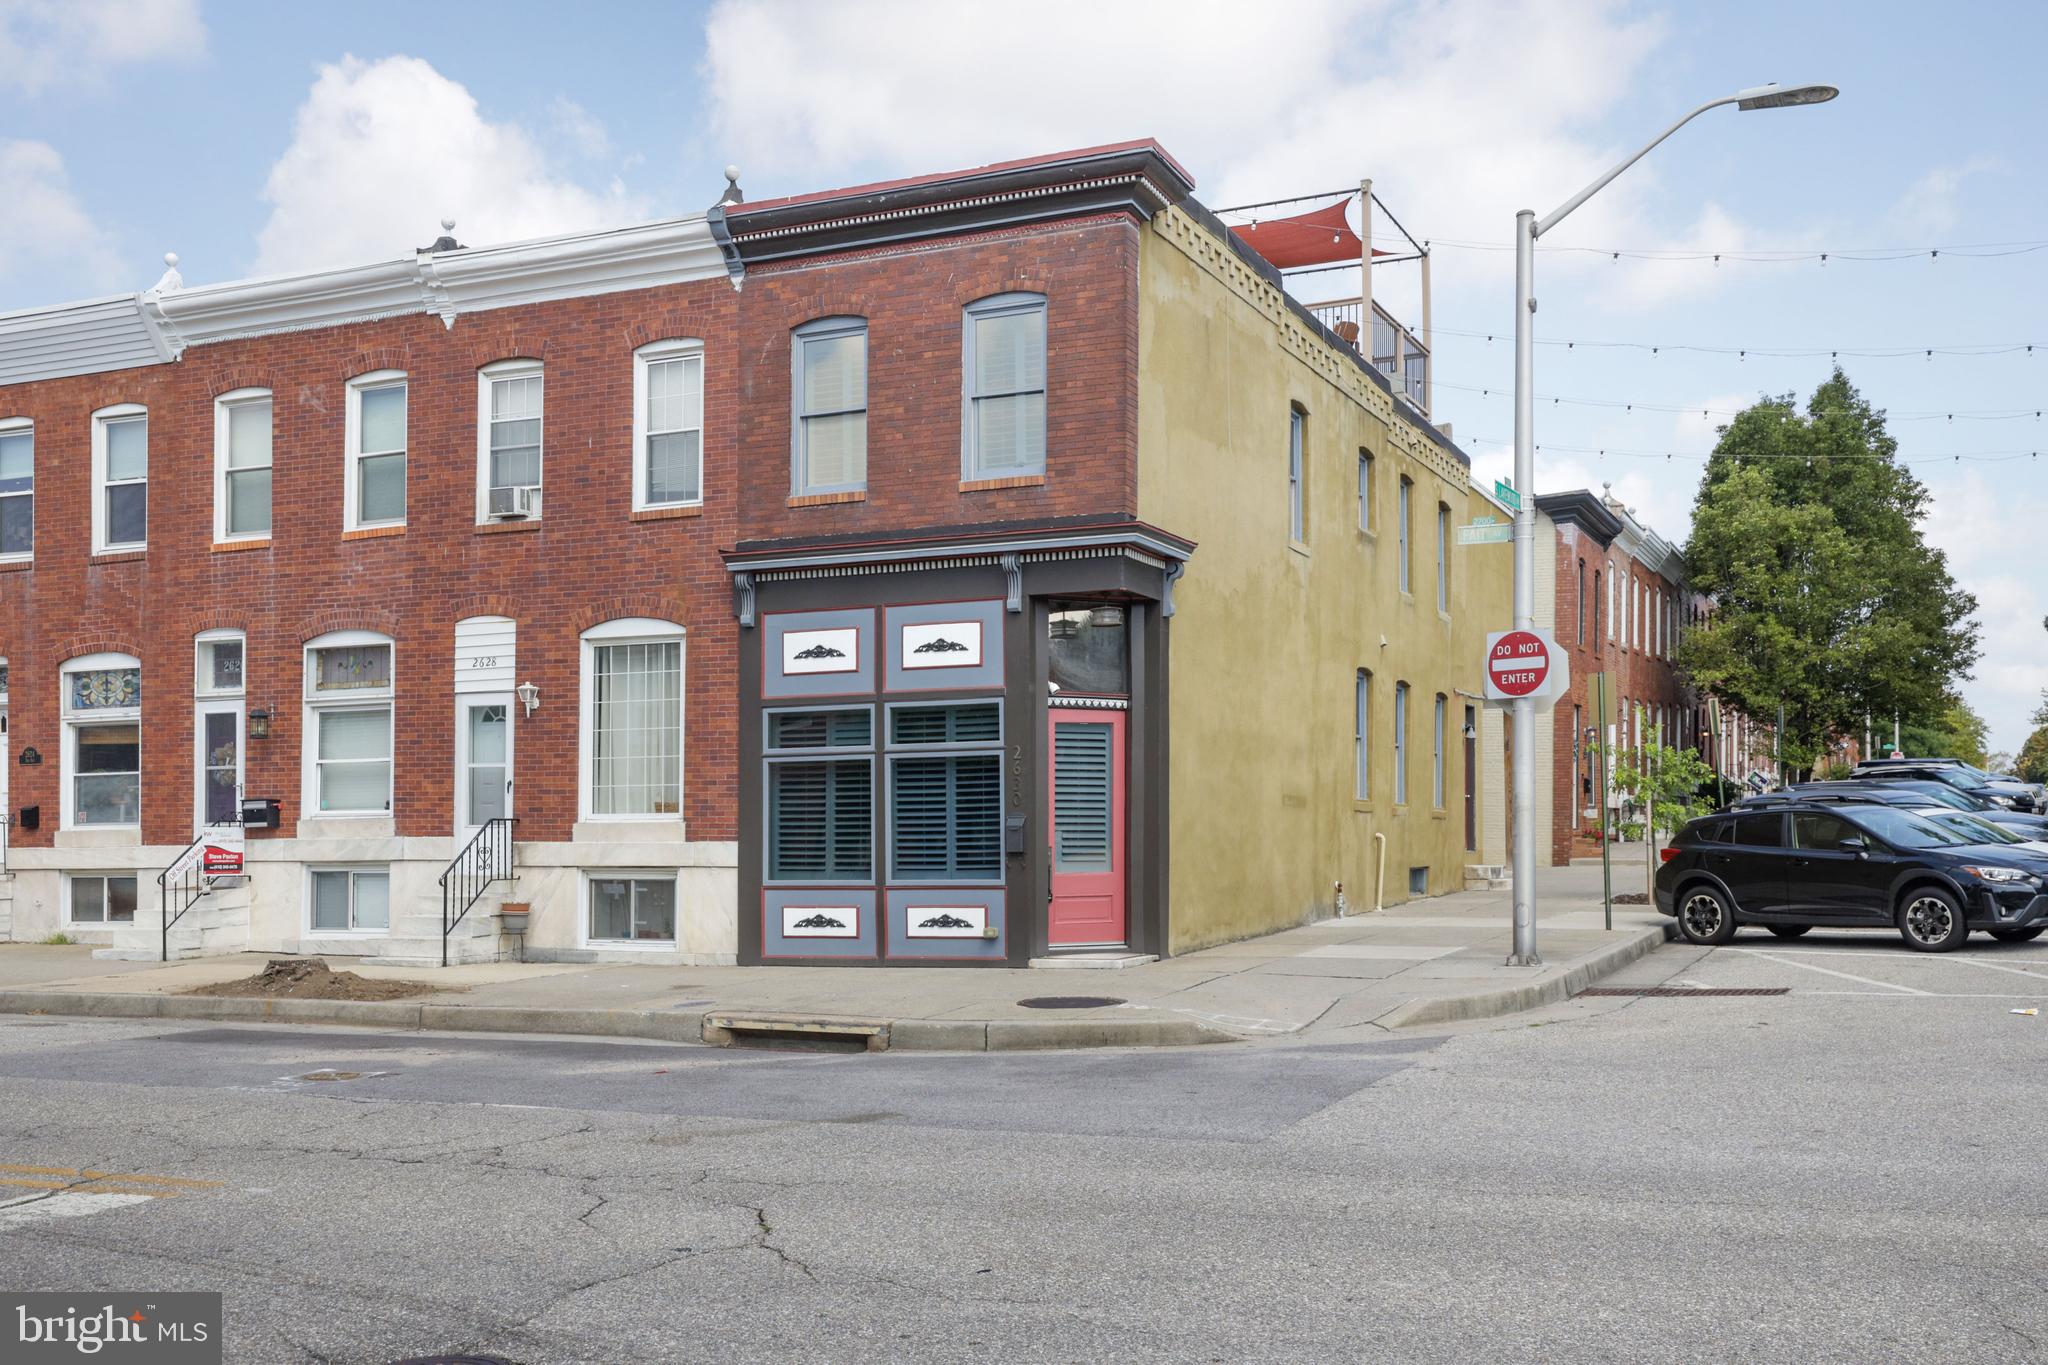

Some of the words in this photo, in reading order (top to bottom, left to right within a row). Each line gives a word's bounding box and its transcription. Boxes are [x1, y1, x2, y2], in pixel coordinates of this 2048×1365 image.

[1497, 645, 1511, 656] DO
[1519, 642, 1540, 654] NOT
[472, 656, 497, 668] 2628
[1501, 672, 1536, 685] ENTER
